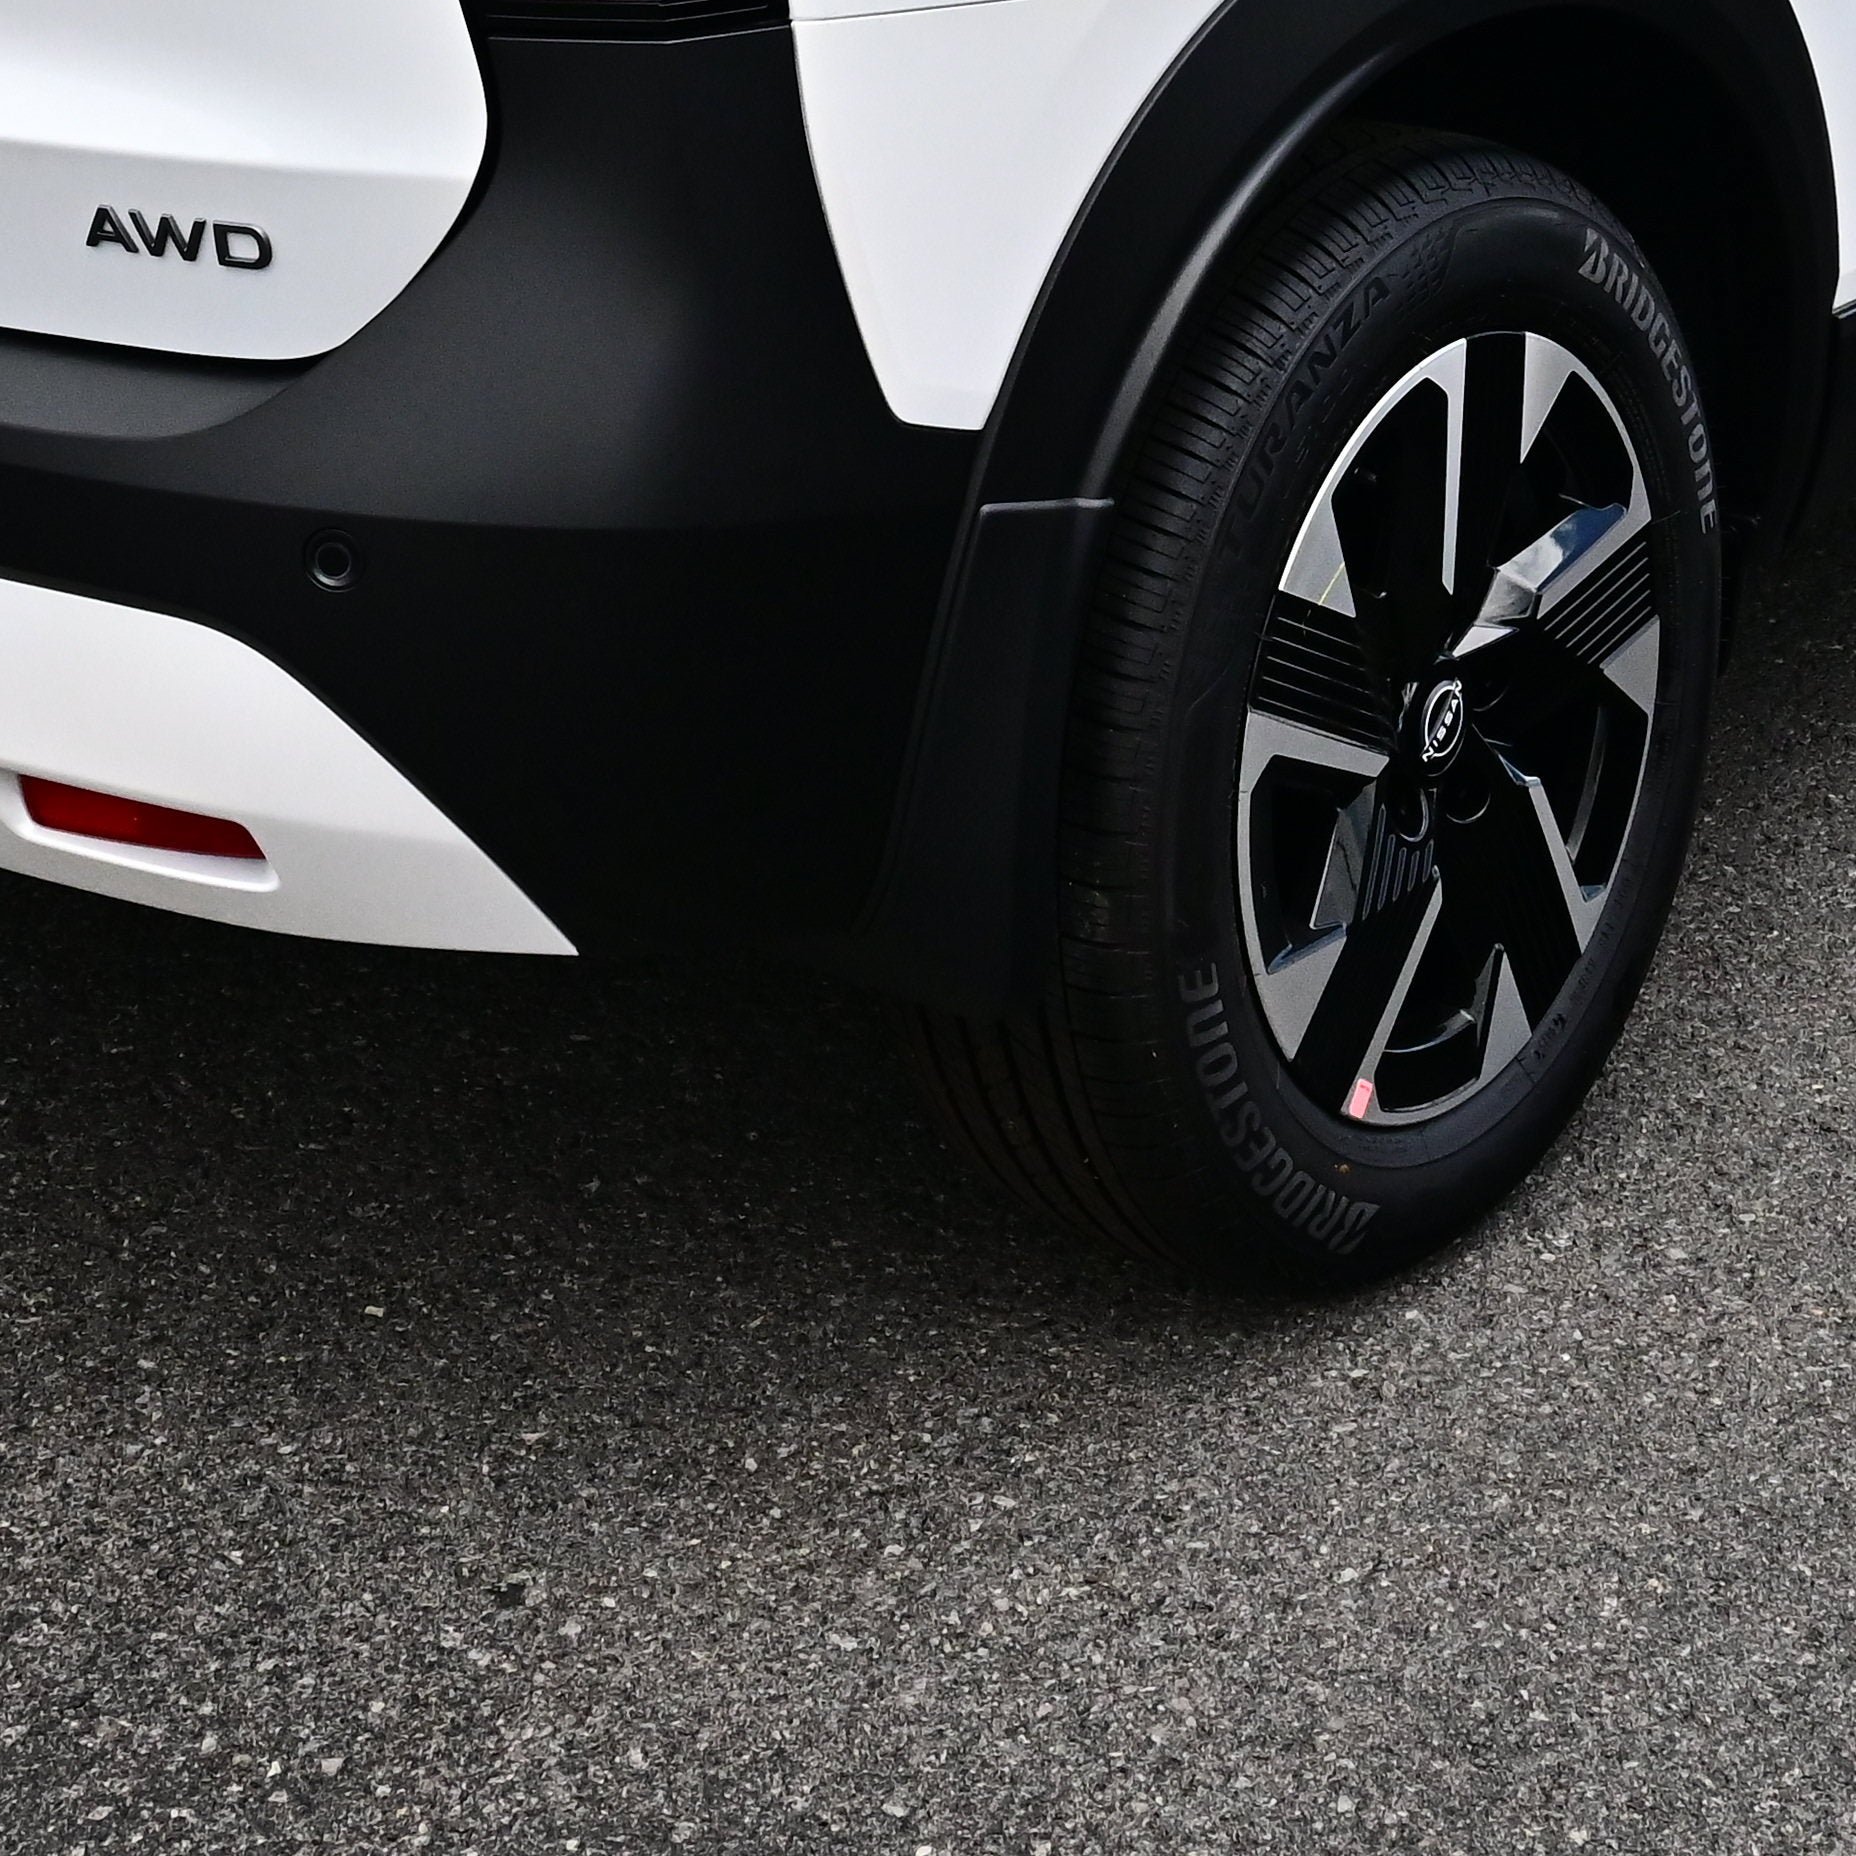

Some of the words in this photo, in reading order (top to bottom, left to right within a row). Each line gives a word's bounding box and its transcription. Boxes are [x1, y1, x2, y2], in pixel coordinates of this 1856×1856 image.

[85, 204, 273, 270] AWD
[1217, 276, 1391, 556] TURANZA
[1577, 226, 1719, 536] BRIDGESTONE
[1177, 961, 1381, 1255] BRIDGESTONE
